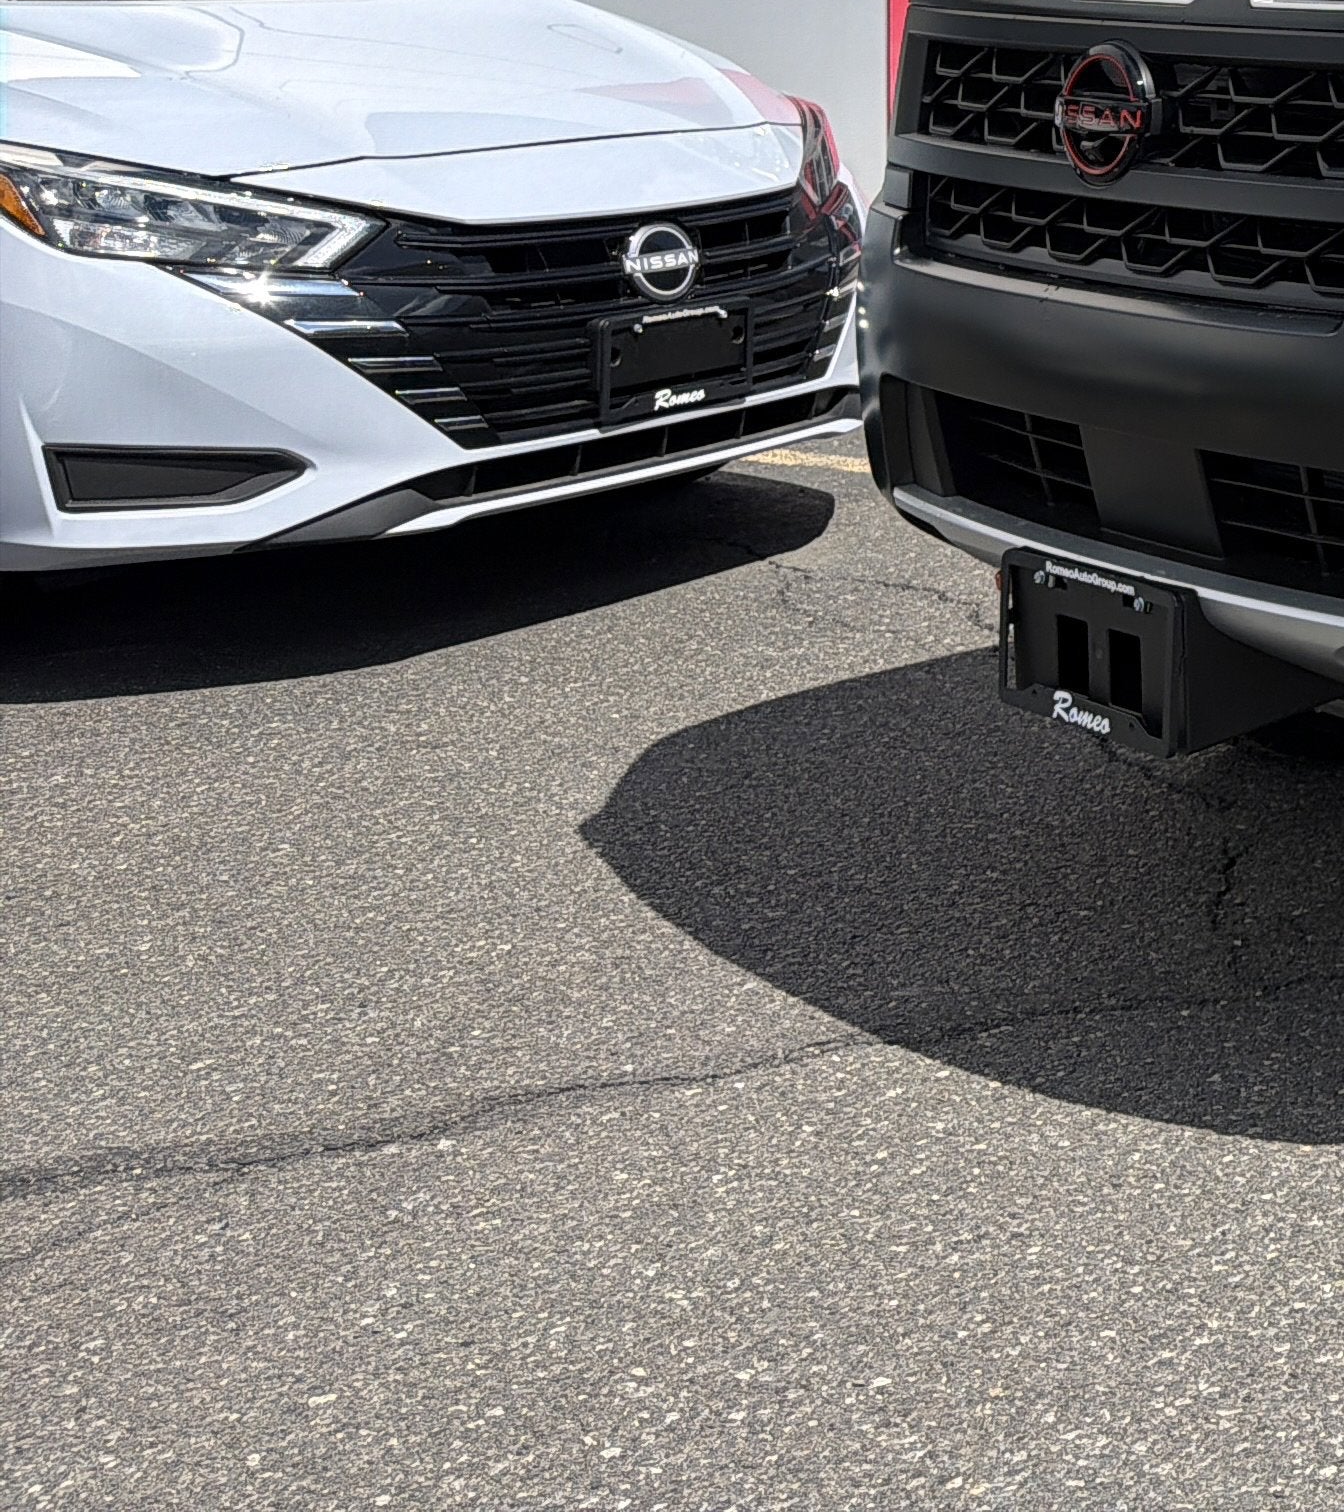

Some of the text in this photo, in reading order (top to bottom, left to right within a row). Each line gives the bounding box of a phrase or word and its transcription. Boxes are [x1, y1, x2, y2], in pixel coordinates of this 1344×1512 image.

[1062, 102, 1144, 129] SSAN
[624, 248, 700, 274] NISSAN
[653, 388, 706, 412] Romeo
[1045, 560, 1136, 596] RomeoAutoGroup.com
[1052, 690, 1111, 735] Romeo
